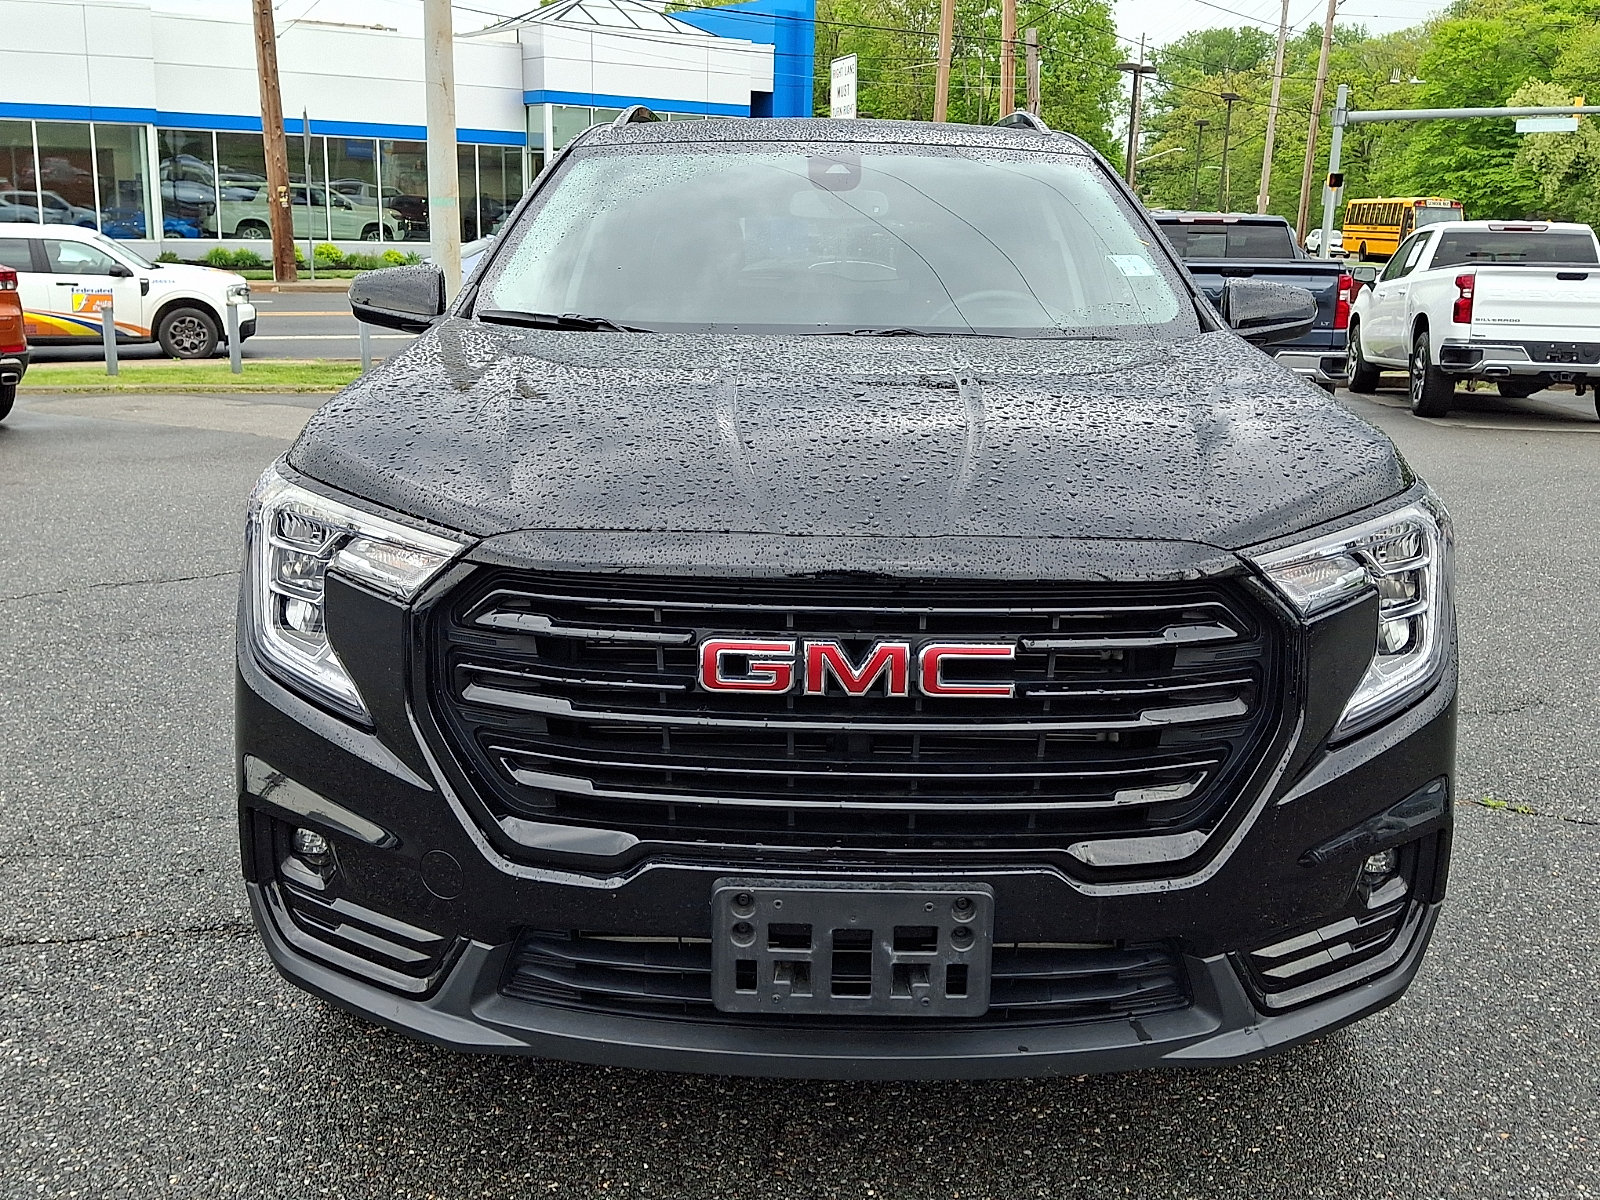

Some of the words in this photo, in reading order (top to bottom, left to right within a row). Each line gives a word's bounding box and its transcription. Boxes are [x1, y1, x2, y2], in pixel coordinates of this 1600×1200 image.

[832, 66, 843, 79] RIGHT
[844, 63, 855, 76] LANE
[836, 83, 850, 98] MUST
[95, 299, 112, 307] Auto
[698, 636, 1017, 698] GMC
